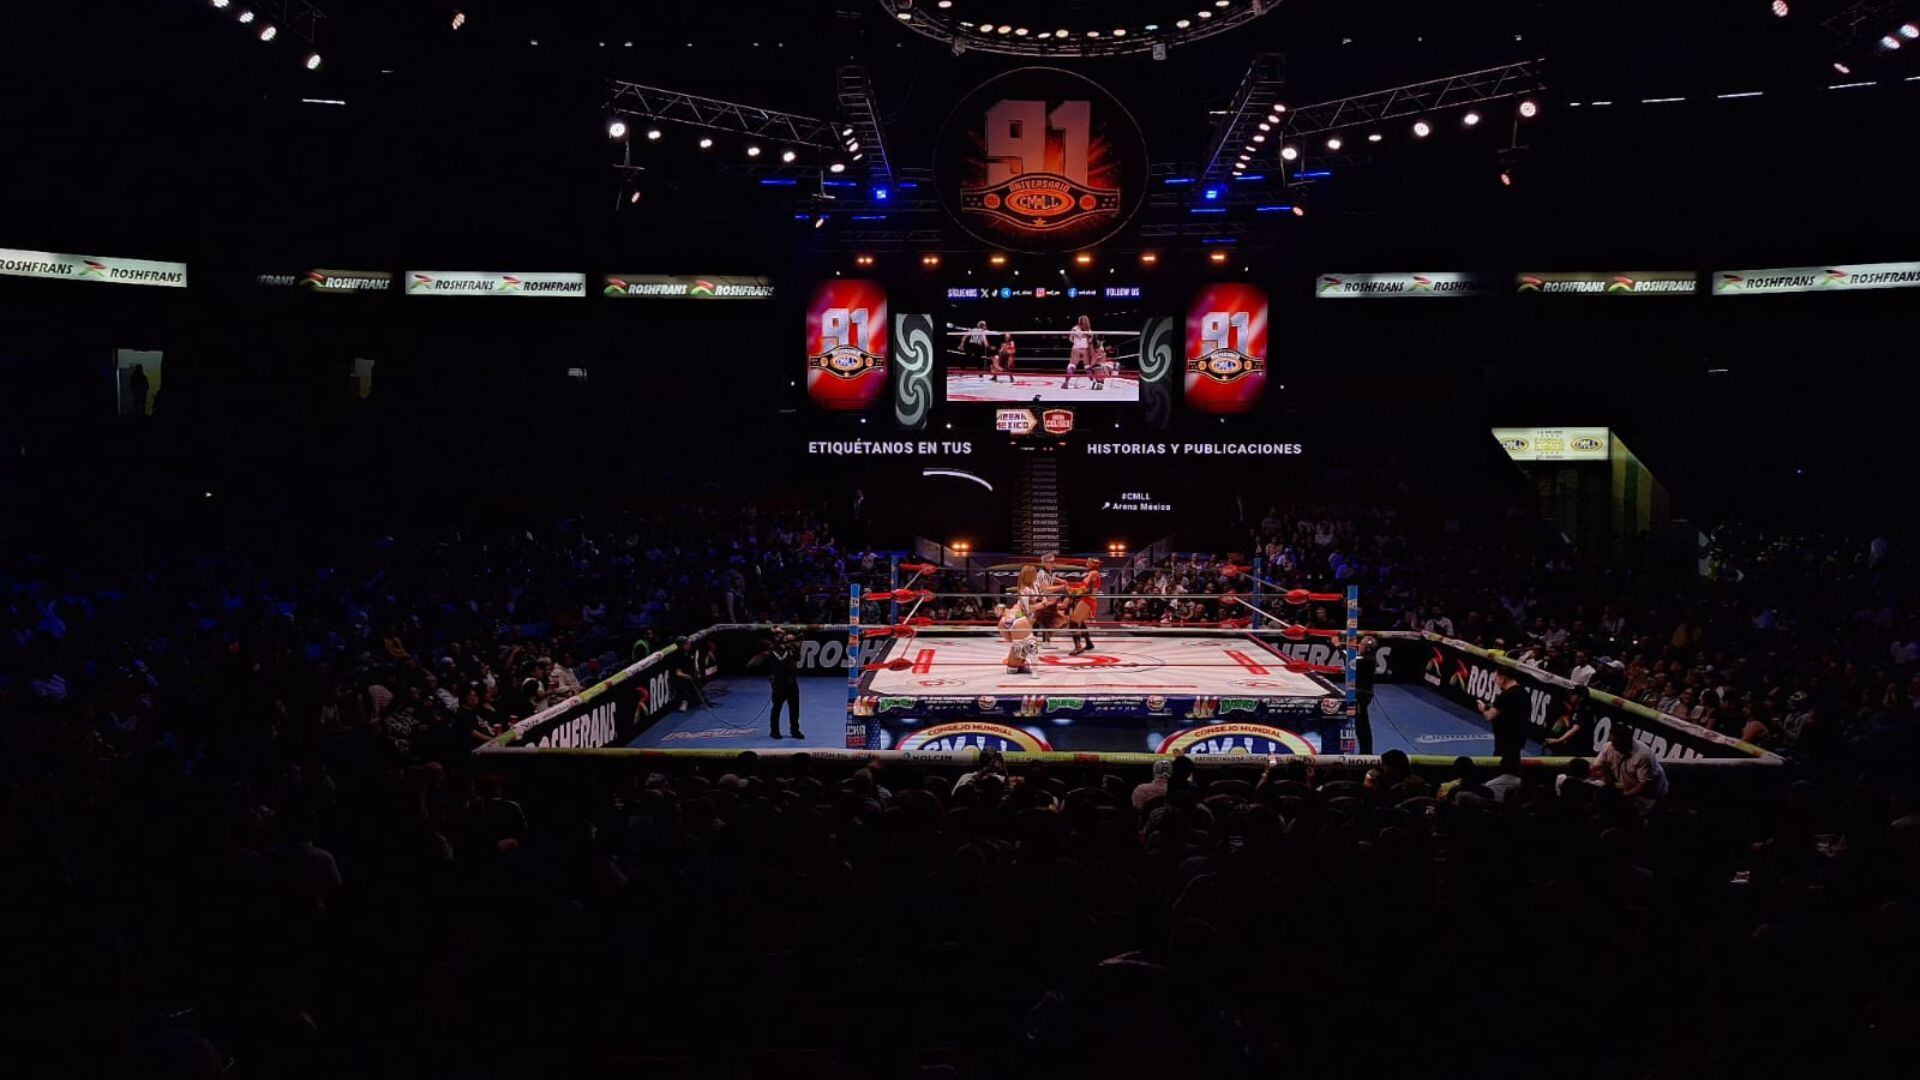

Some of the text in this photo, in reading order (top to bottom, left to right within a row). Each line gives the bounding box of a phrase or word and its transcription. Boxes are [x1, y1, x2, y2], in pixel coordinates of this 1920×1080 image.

[984, 100, 1092, 186] 91
[110, 268, 182, 283] ROSHFRANS
[1746, 275, 1816, 288] ROSHFRANS
[325, 277, 390, 290] ROSHFRANS
[435, 279, 583, 292] ROSHFRANS ROSHFRANS
[628, 283, 774, 297] ROSHFRANS ROSHFRANS
[1344, 281, 1404, 293] ROSHFRANS
[1542, 279, 1697, 293] ROSHFRANS ROSHFRANS
[1106, 288, 1129, 297] FOLLOW
[1130, 288, 1140, 296] US
[821, 307, 869, 351] 91
[1201, 311, 1249, 355] 91
[808, 438, 972, 456] ETIQUÉTANOS EN TUS
[1087, 443, 1302, 454] HISTORIAS Y PUBLICACIONES
[1121, 492, 1151, 500] #CMLL
[1112, 503, 1138, 511] Arena
[928, 724, 1013, 736] CONSEJO MUNDIAL
[1195, 726, 1282, 738] CONSEJO MUNDIAL
[913, 753, 952, 761] HOLCIM
[1349, 759, 1382, 768] HOLCI
